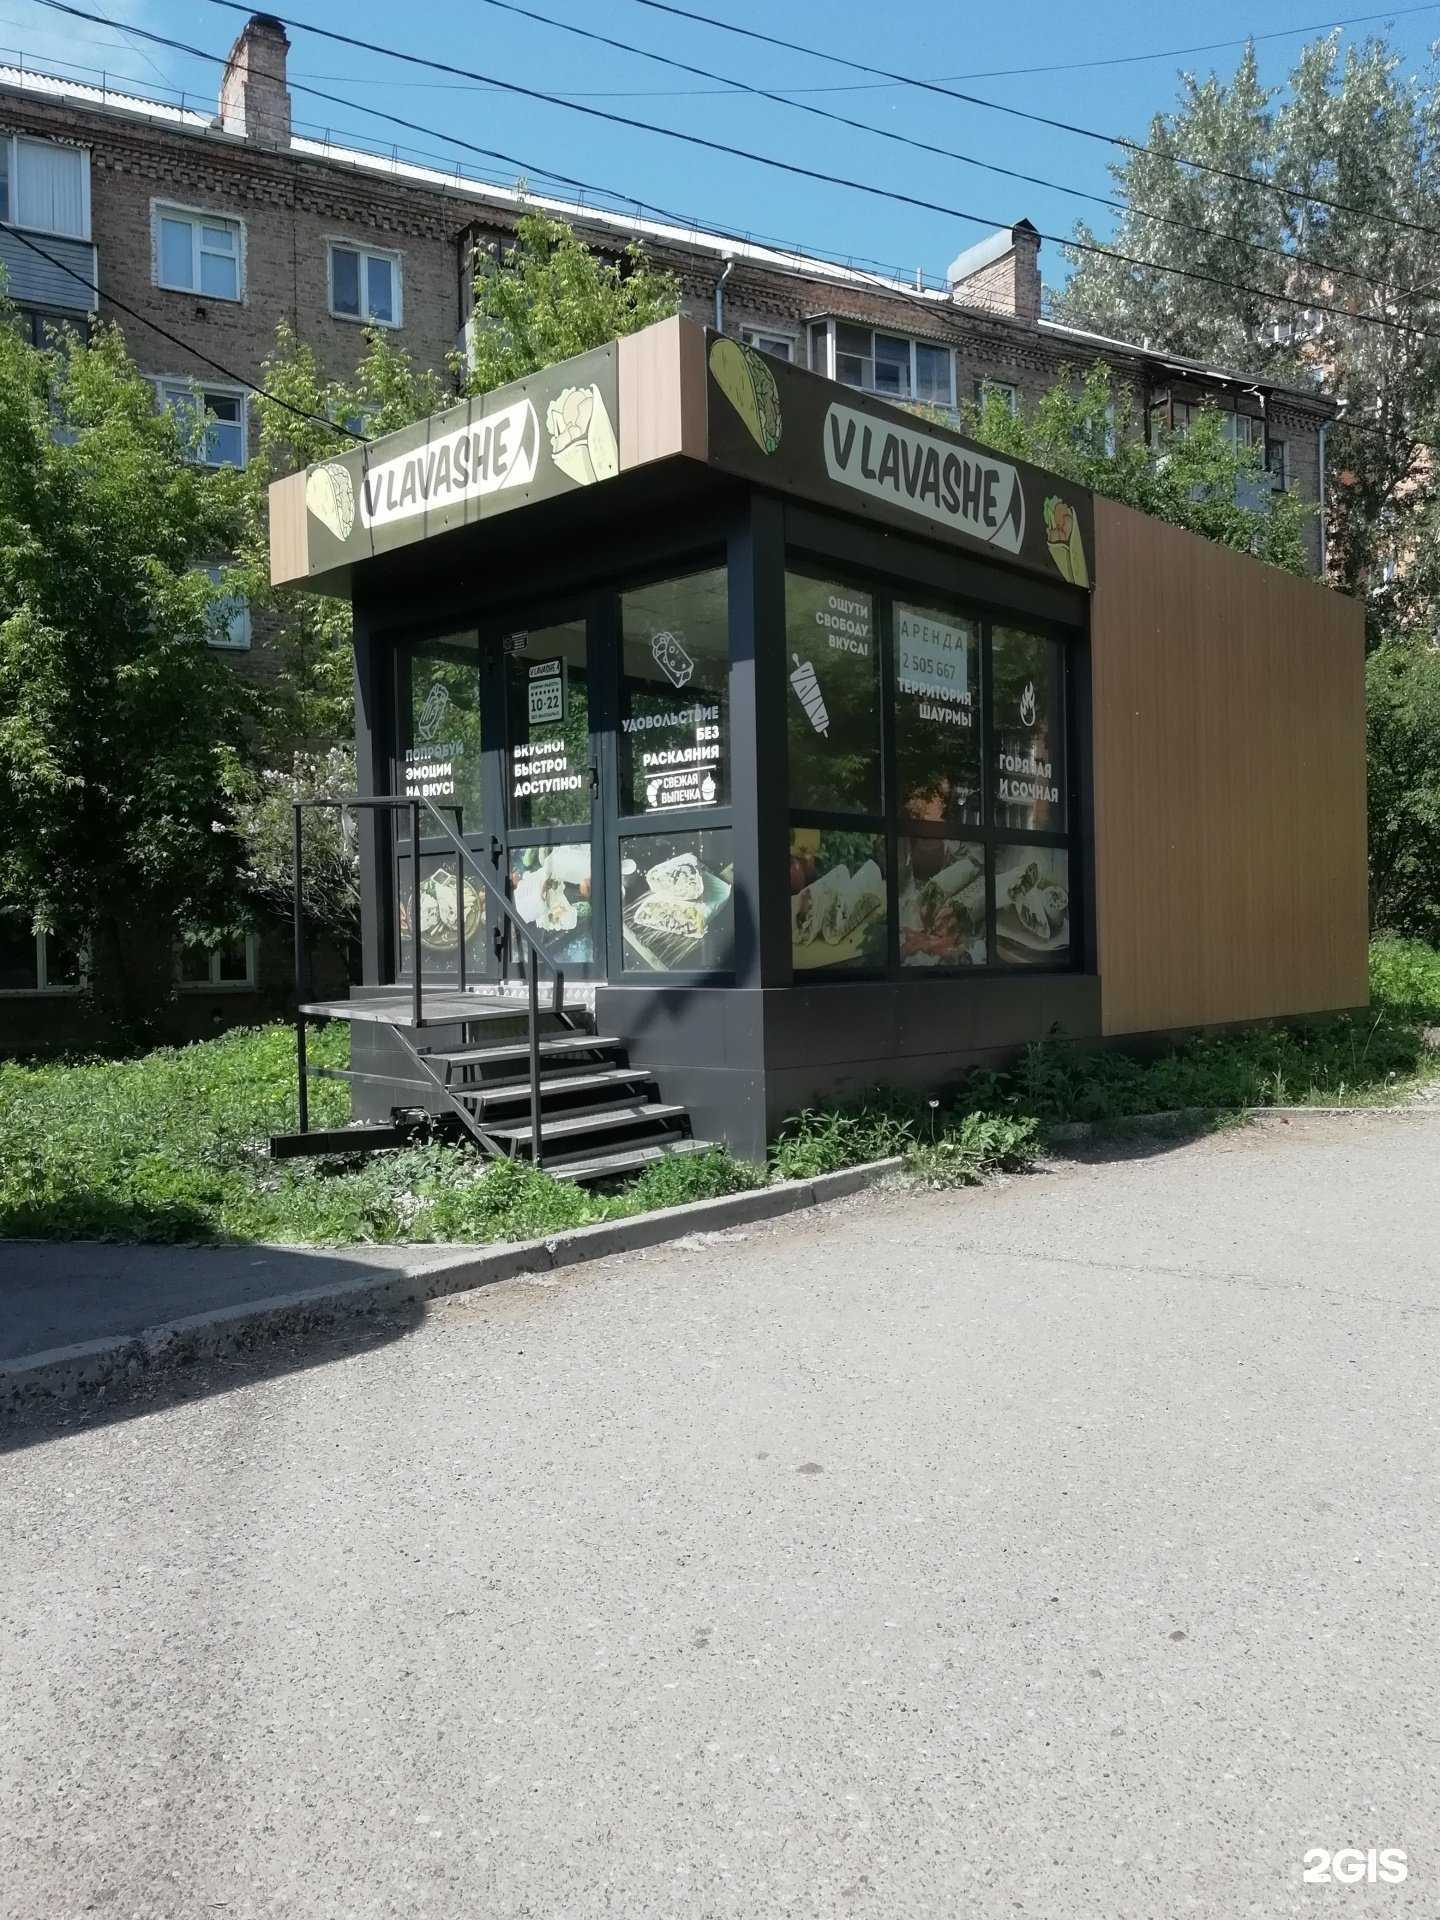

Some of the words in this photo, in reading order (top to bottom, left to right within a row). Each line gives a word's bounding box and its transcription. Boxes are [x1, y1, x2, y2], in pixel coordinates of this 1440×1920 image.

[386, 417, 512, 508] LAVASHE
[861, 425, 1000, 528] LAVASHE
[829, 596, 868, 619] ОЩУТИ
[815, 612, 869, 637] СВОБОДУ
[901, 620, 963, 652] АРЕНДА
[829, 634, 868, 657] ВКУСА!
[903, 652, 909, 669] 2
[897, 677, 972, 706] ТЕРРИТОРИЯ
[622, 705, 719, 733] УДОВОЛЬСТВИЕ
[919, 704, 972, 728] ШАУРМЫ
[696, 725, 720, 742] БЕЗ
[514, 739, 565, 758] ВКУСНО!
[642, 744, 720, 767] РАСКАЯНИЯ
[405, 763, 452, 780] ЭМОЦИИ
[514, 757, 567, 778] БЫСТРО!
[406, 785, 420, 797] НА
[422, 781, 454, 797] ВКУС!
[514, 774, 582, 798] ДОСТУПНО!
[663, 772, 699, 790] СВЕЖАЯ
[1011, 780, 1059, 803] СОЧНАЯ
[661, 787, 701, 805] ВЫПЕЧКА
